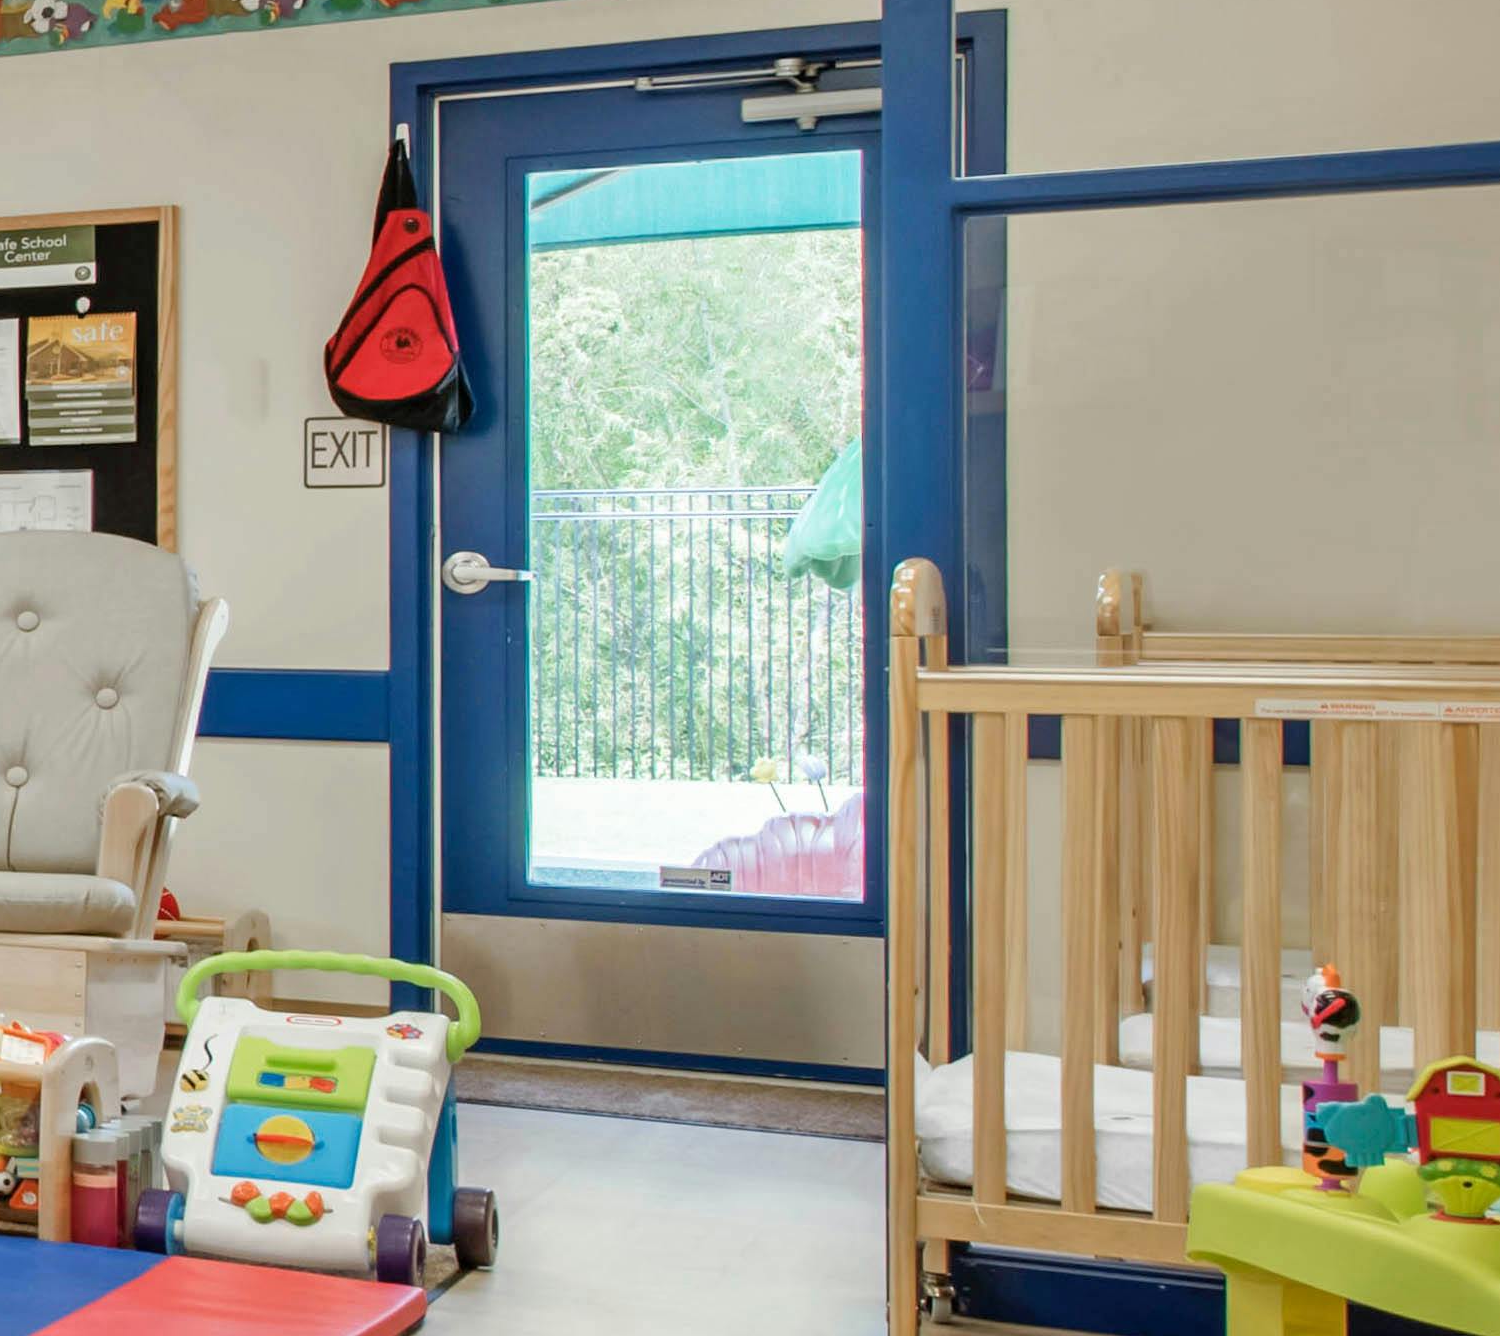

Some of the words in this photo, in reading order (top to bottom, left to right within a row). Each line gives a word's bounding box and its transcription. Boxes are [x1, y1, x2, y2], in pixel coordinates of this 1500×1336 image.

[21, 234, 67, 250] School
[4, 251, 51, 264] Center
[71, 320, 124, 342] safe
[310, 429, 379, 469] EXIT
